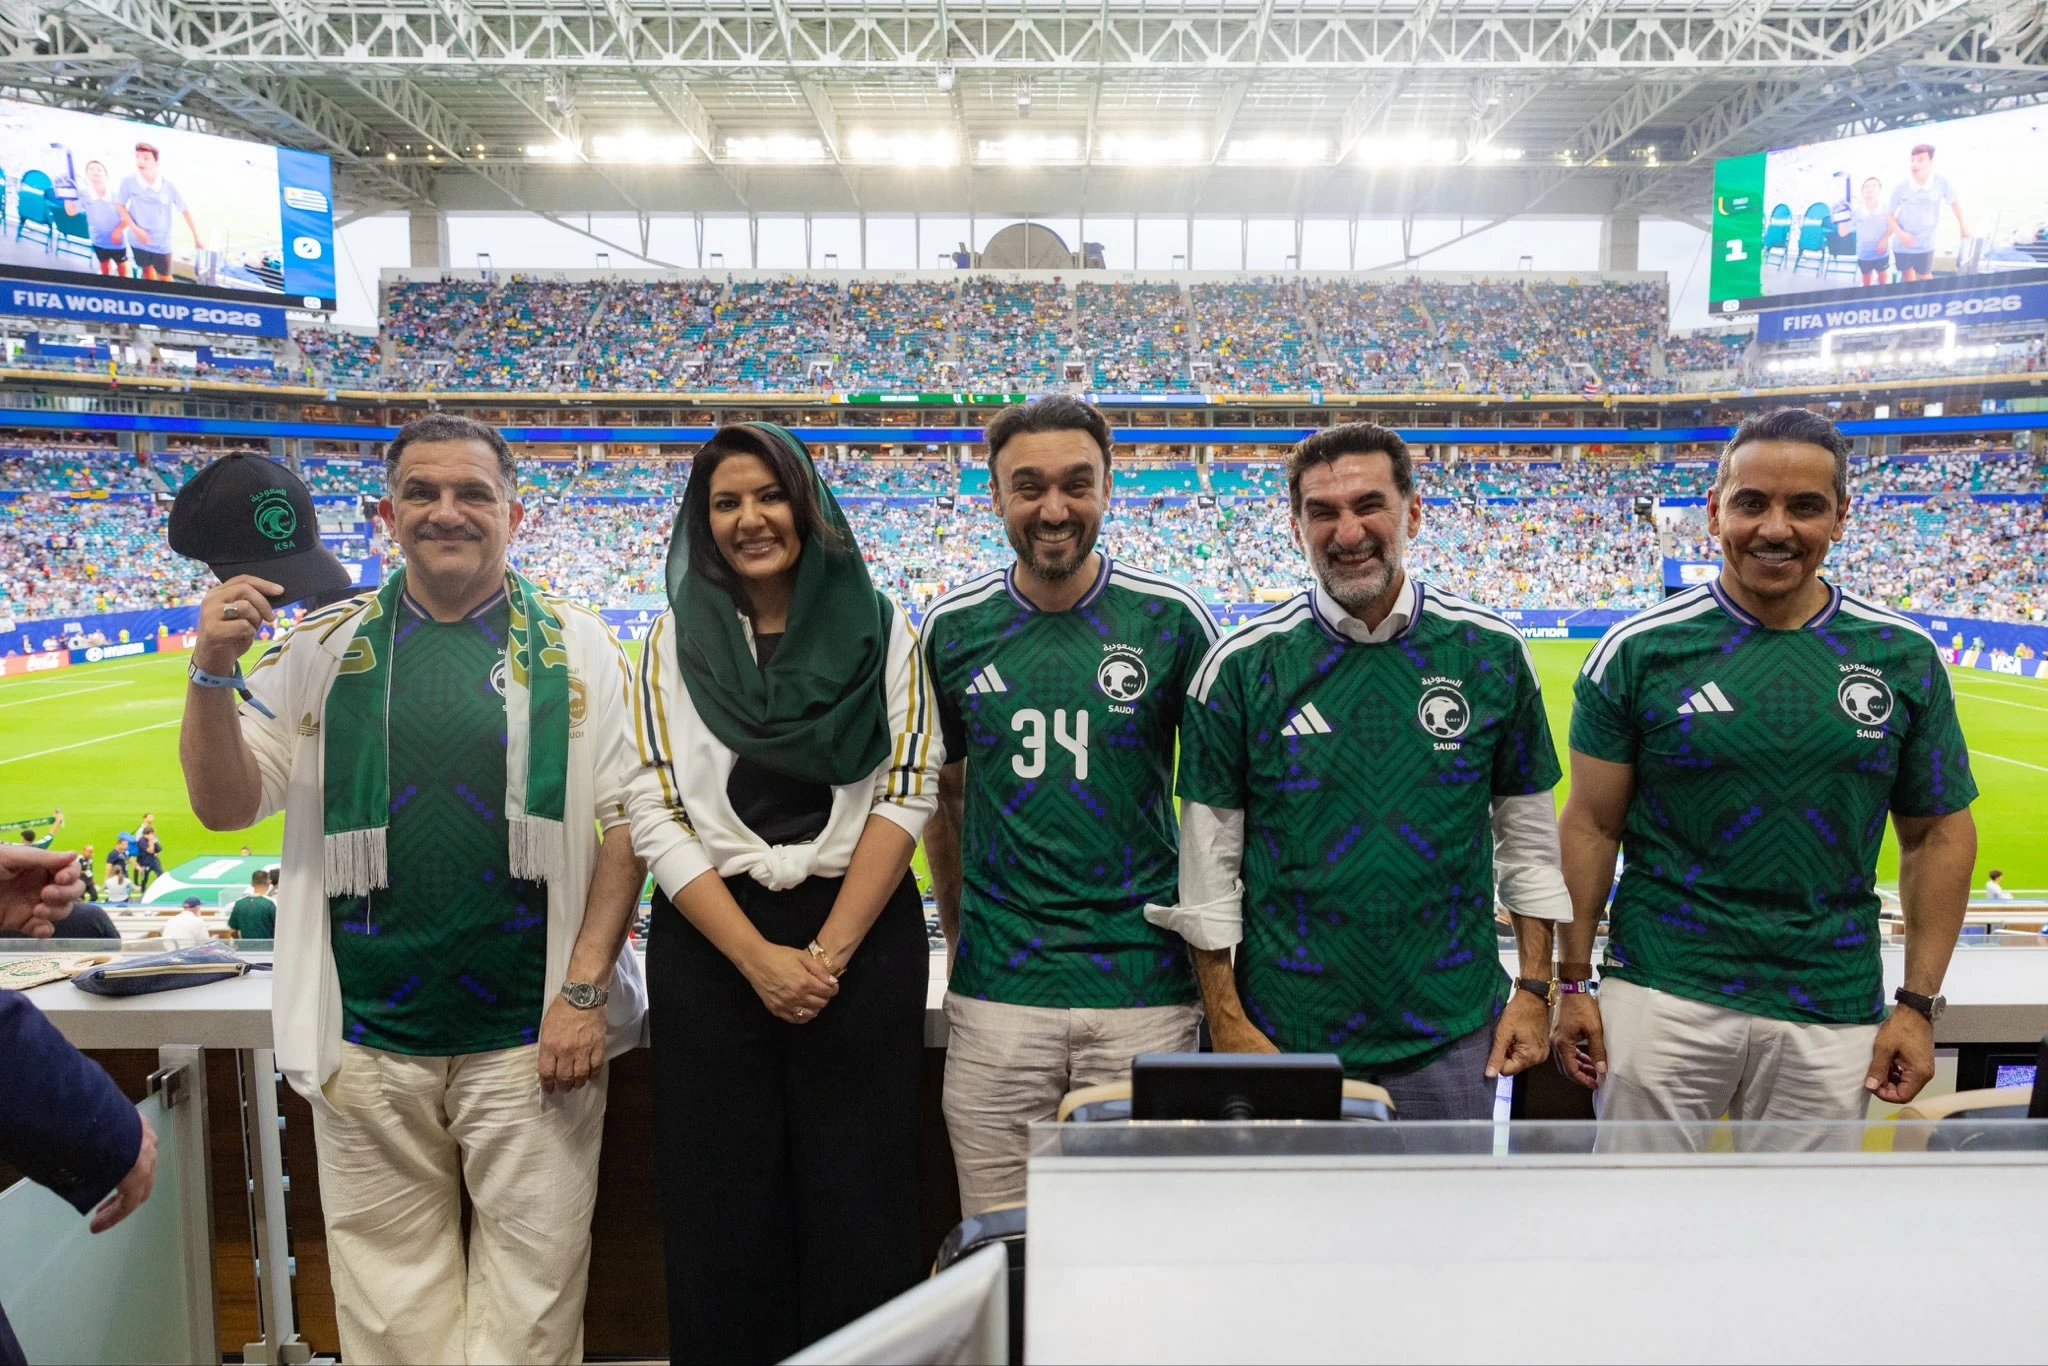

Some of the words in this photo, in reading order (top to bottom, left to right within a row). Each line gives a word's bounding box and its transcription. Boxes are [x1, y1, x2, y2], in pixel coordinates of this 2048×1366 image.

[1725, 239, 1748, 262] 1
[13, 290, 62, 309] FIFA
[65, 295, 145, 317] WORLD
[148, 303, 190, 320] CUP
[192, 309, 262, 328] 2026
[1783, 311, 1823, 331] FIFA
[1826, 305, 1897, 328] WORLD
[1900, 301, 1942, 321] CUP
[1945, 294, 2022, 316] 2026
[249, 488, 287, 503] السعودية
[275, 540, 296, 552] KSA
[1502, 611, 1523, 620] FIFA
[1102, 643, 1144, 655] السعودية
[1838, 664, 1883, 677] السعودية
[1988, 653, 2022, 676] VISA
[1421, 676, 1463, 688] السعودية
[1108, 704, 1135, 715] SAUDI
[569, 731, 584, 740] UDI
[1856, 729, 1884, 740] SAUDI
[1010, 708, 1089, 780] 34
[1433, 742, 1460, 751] SAUDI
